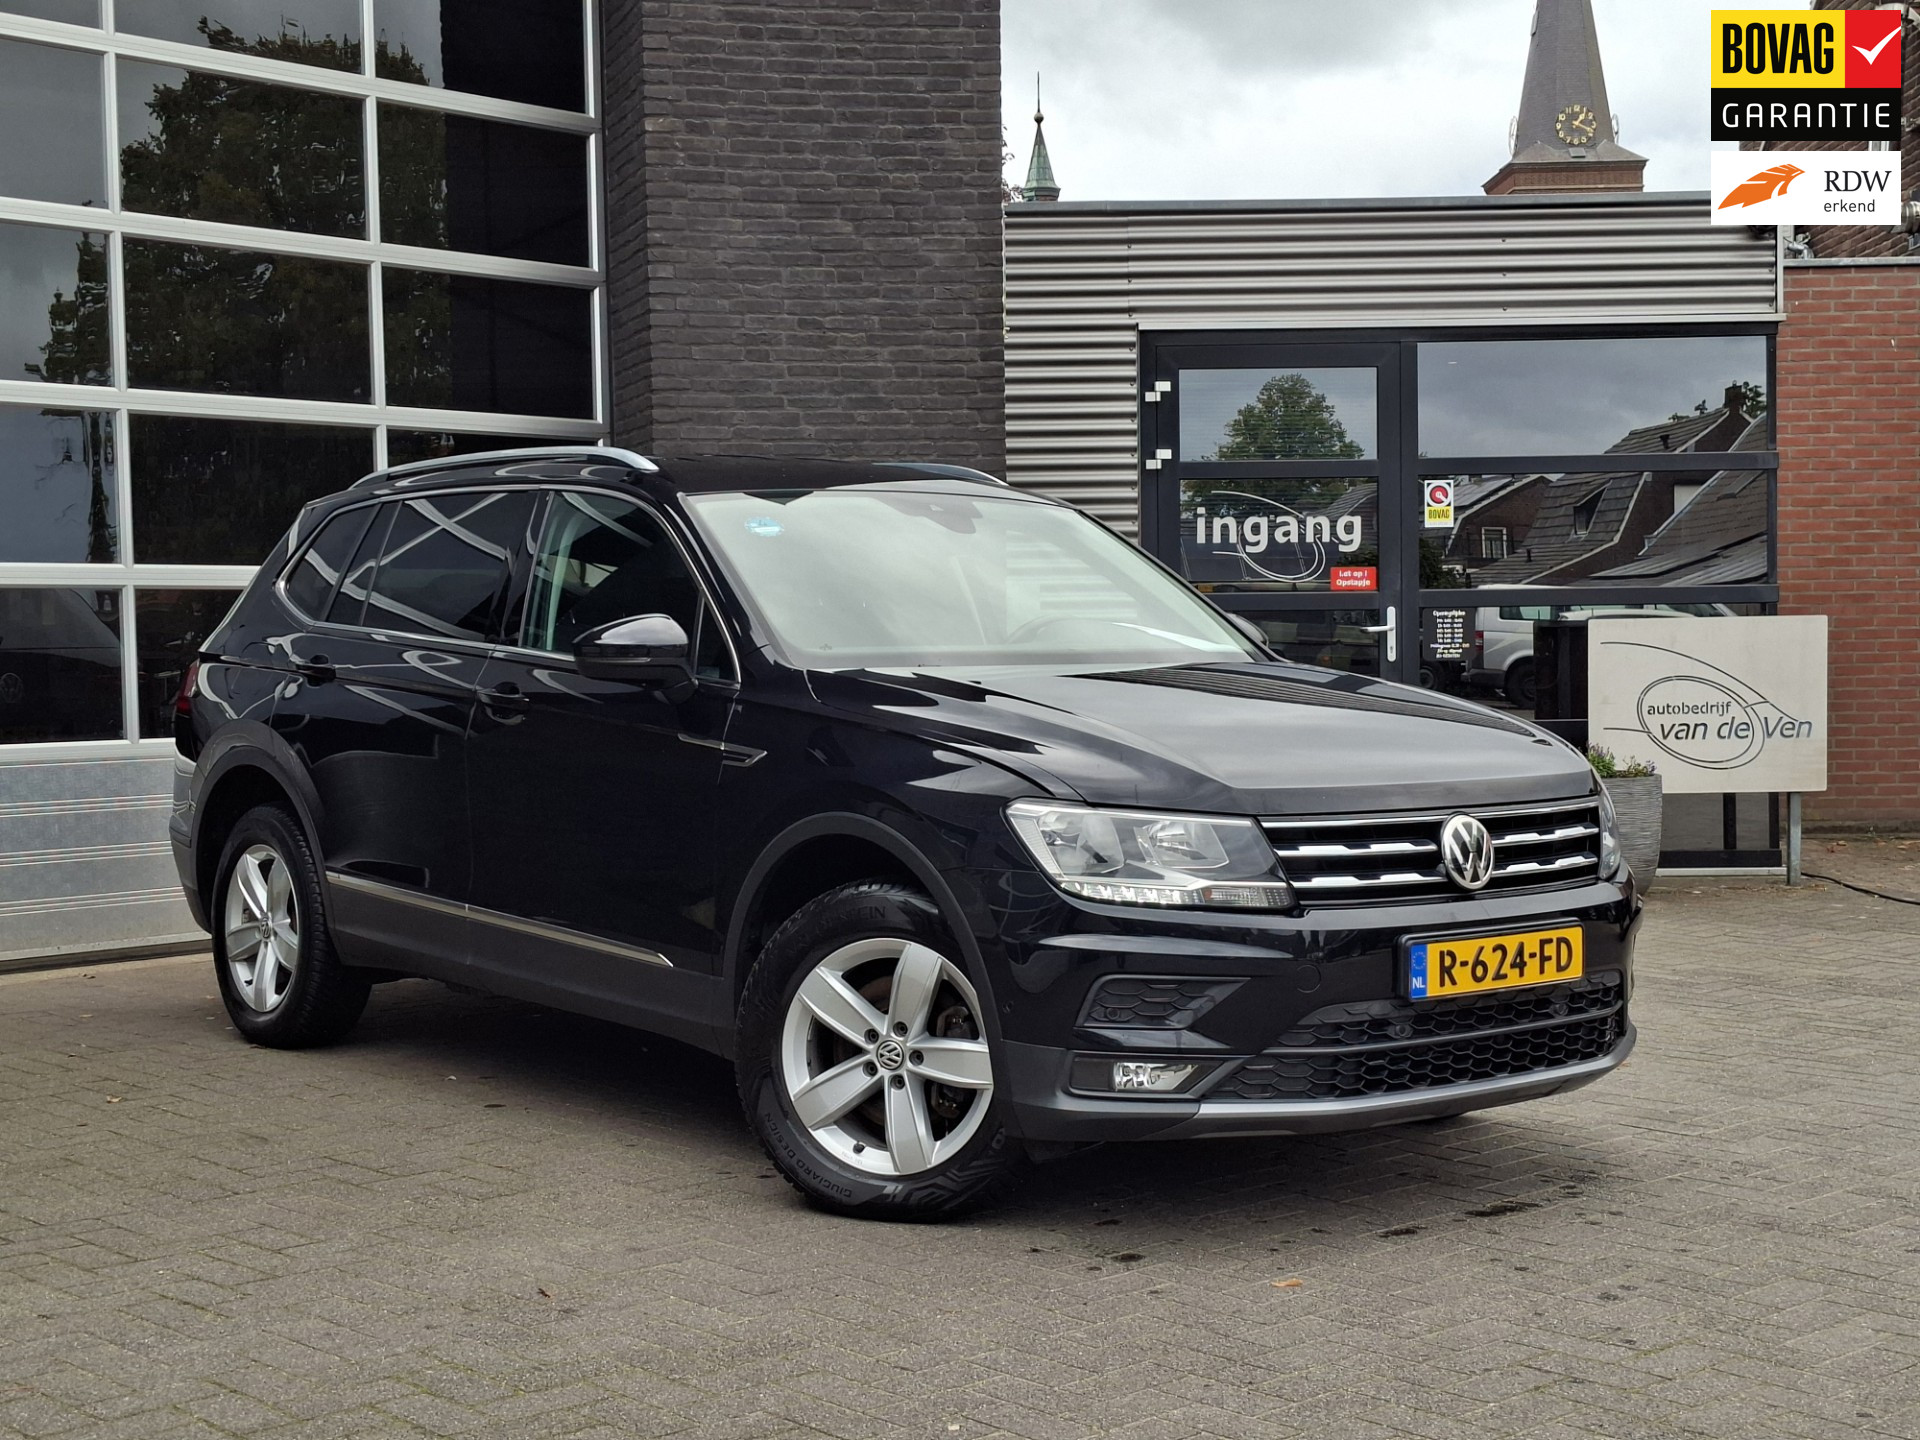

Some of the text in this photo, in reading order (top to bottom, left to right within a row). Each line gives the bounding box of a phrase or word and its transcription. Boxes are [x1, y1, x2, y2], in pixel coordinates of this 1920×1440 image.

[1428, 509, 1450, 519] BOVAG
[1196, 506, 1362, 553] ingang
[1336, 578, 1371, 587] Opstapje
[1647, 701, 1732, 717] autobedrijf
[1660, 716, 1813, 740] van de Ven
[1439, 936, 1573, 988] R-624-FD
[1412, 976, 1425, 989] NL
[765, 1112, 796, 1158] DESIGN
